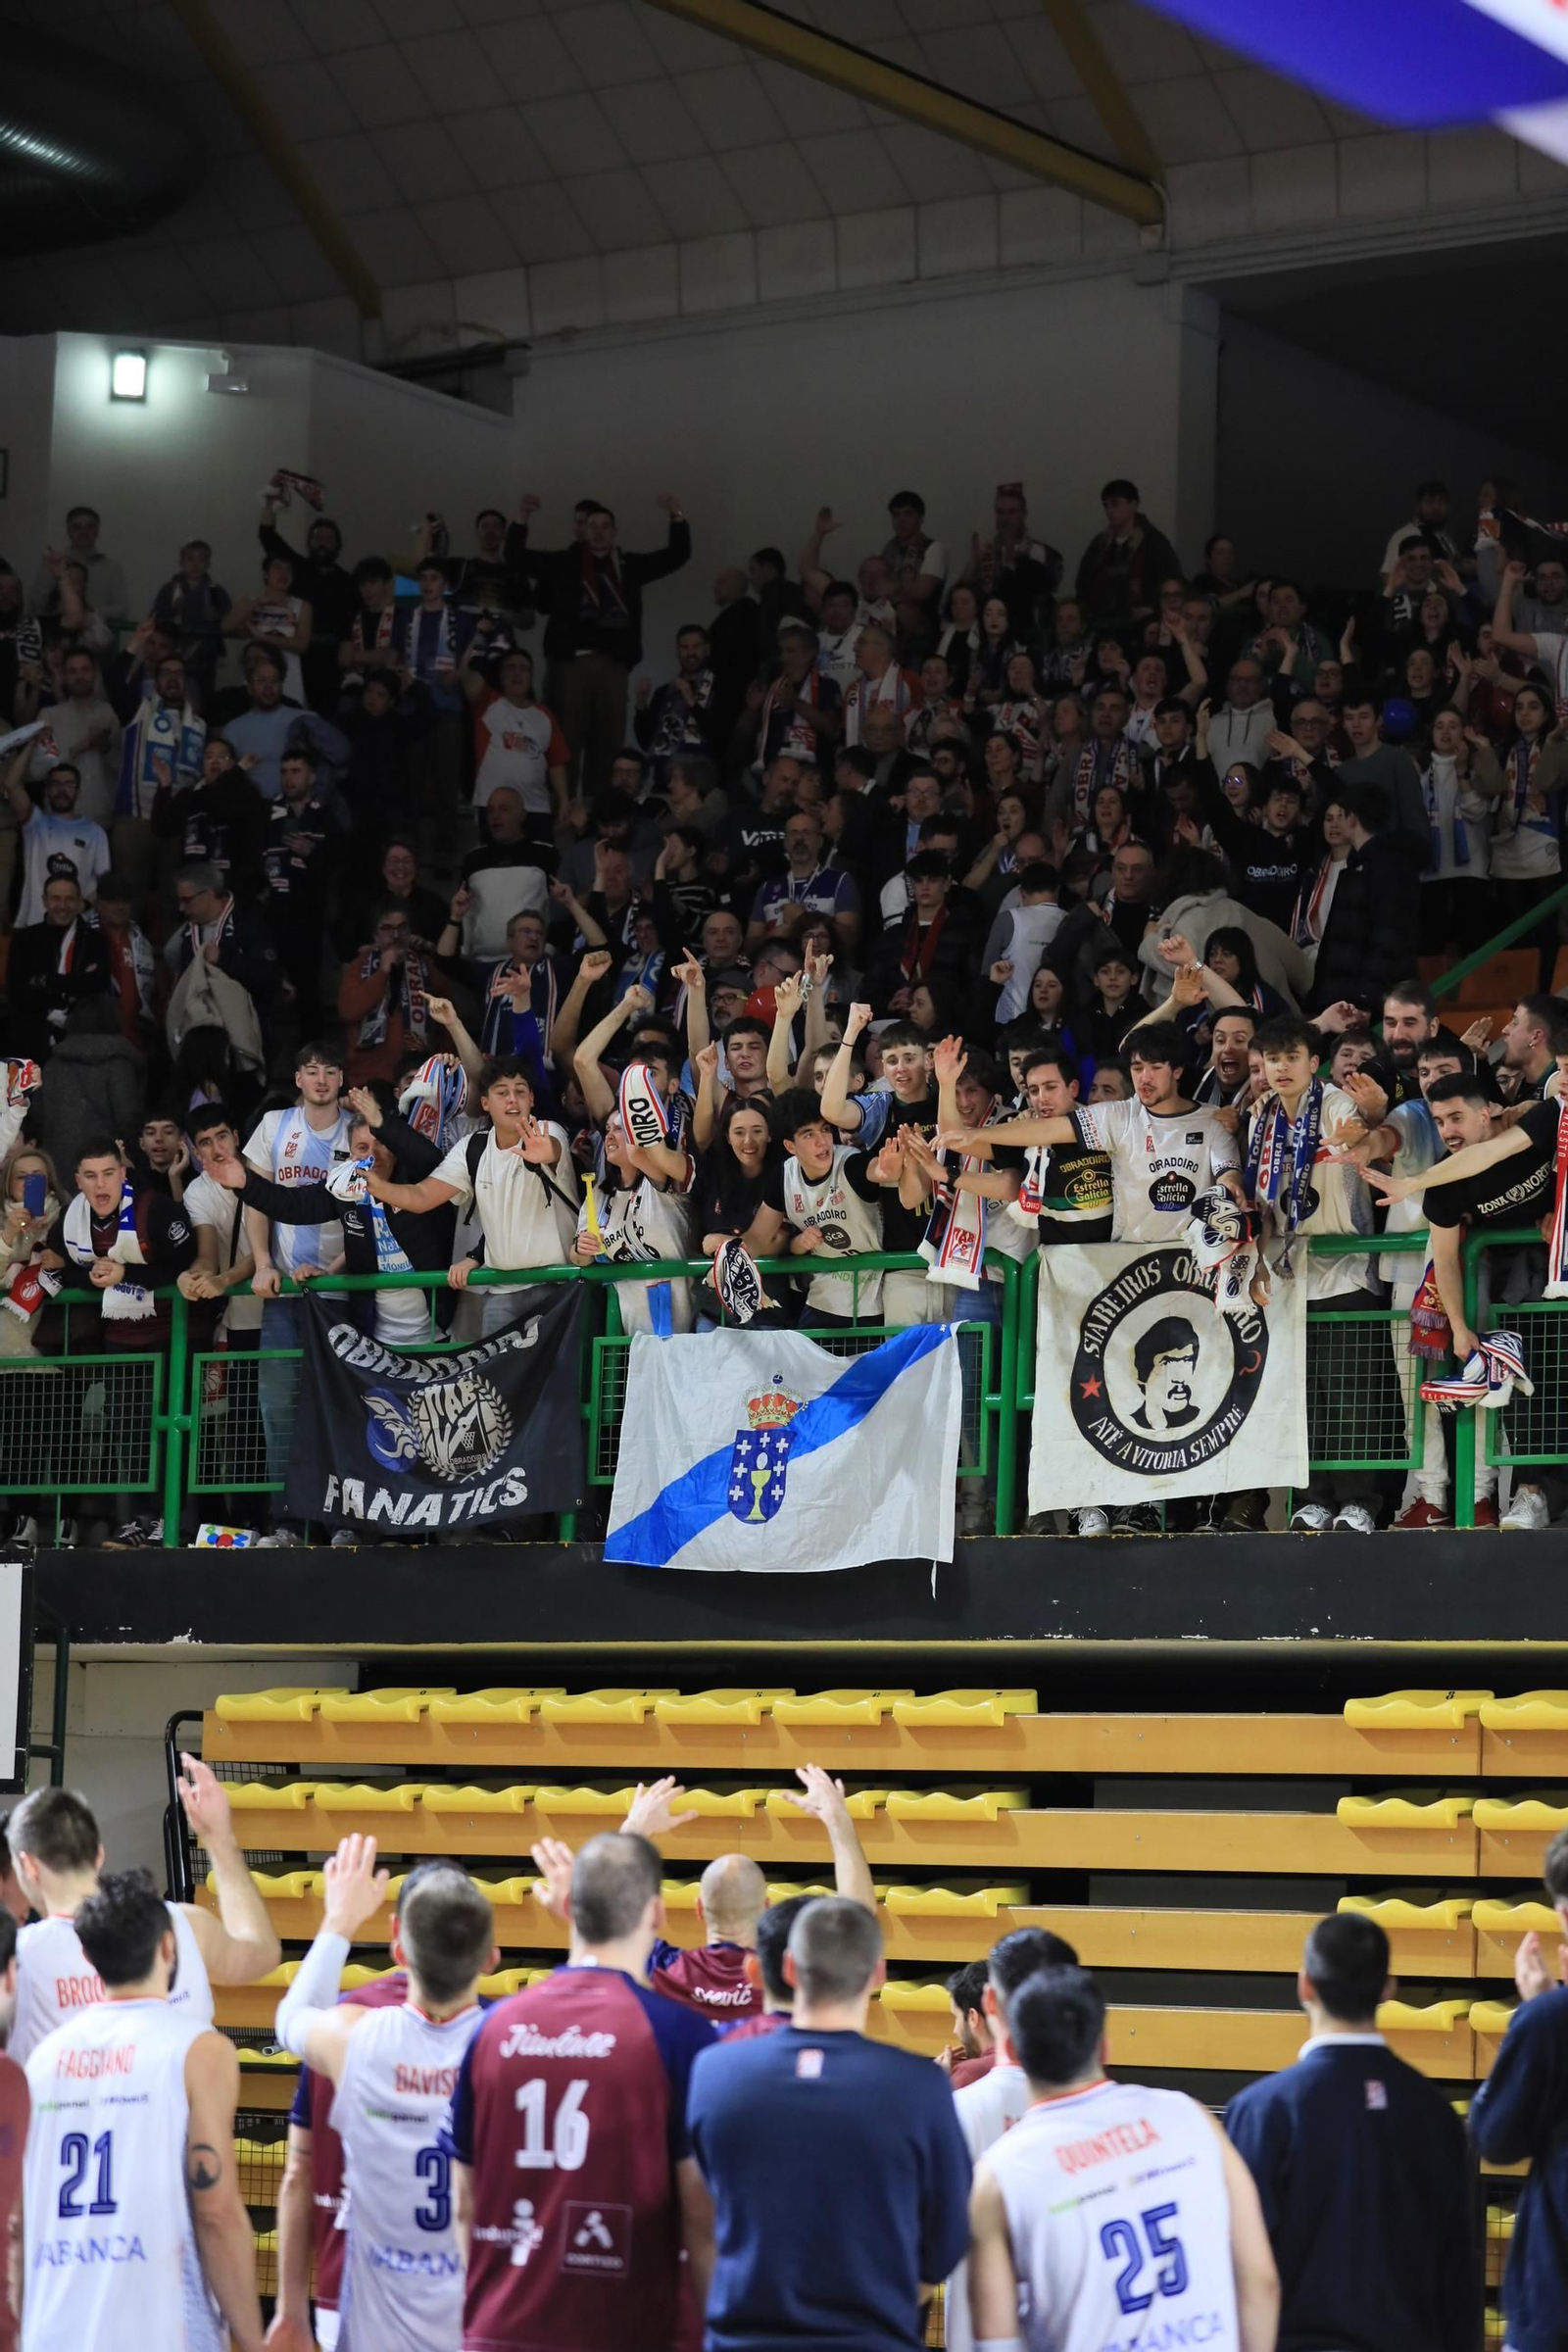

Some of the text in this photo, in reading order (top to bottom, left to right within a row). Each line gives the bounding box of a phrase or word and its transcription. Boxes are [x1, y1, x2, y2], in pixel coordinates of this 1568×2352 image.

[1073, 1179, 1109, 1193] Estrella
[1477, 1195, 1509, 1214] ZONA
[1116, 1441, 1134, 1460] A
[1131, 1445, 1188, 1470] VITORIA
[323, 1467, 528, 1526] FANATICS
[56, 2043, 136, 2080] FAGGIANO
[515, 2078, 590, 2171] 16
[1054, 2117, 1161, 2176] QUINTELA
[59, 2130, 118, 2218] 21
[416, 2147, 451, 2231] 3
[1100, 2202, 1189, 2315] 25
